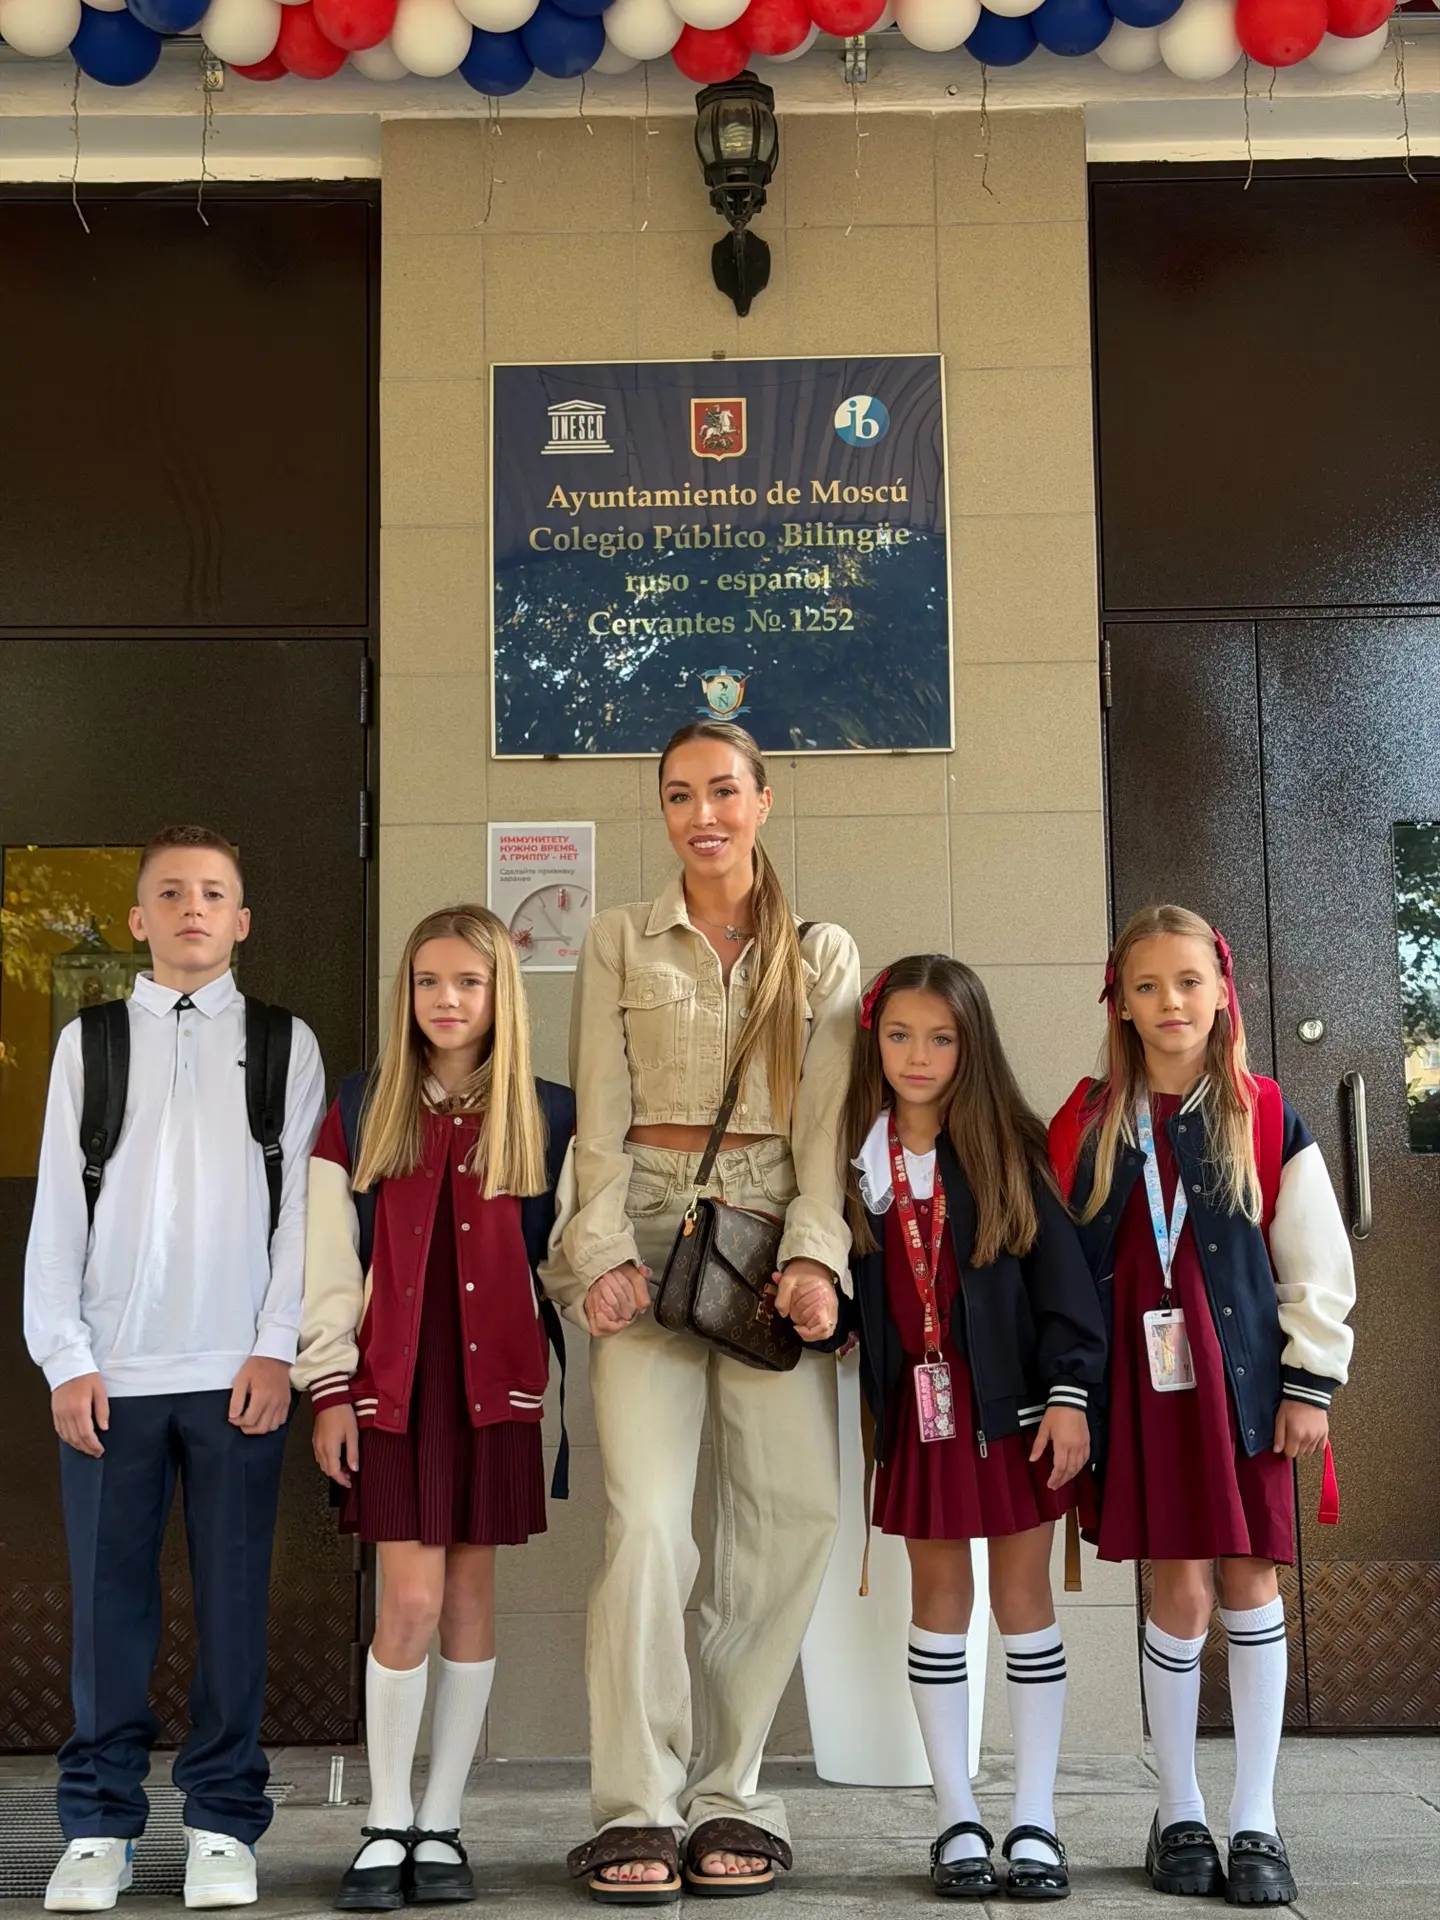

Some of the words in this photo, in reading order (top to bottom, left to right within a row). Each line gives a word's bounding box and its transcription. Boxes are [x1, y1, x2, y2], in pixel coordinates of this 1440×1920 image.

[551, 414, 604, 441] UNESCO
[846, 399, 880, 441] ib
[546, 481, 758, 517] Ayuntamiento
[766, 479, 802, 506] de
[810, 477, 909, 504] Moscú
[529, 524, 645, 559] Colegio
[652, 523, 766, 549] Público
[782, 521, 911, 554] Bilingüe
[624, 573, 690, 593] ruso
[716, 564, 832, 599] español
[587, 610, 737, 636] Cervantes
[789, 607, 855, 633] 1252
[499, 835, 570, 844] ИММУНИТЕТУ
[499, 844, 539, 853] НУЖНО
[540, 844, 578, 853] ВРЕМЯ,
[499, 854, 507, 862] А
[510, 853, 551, 861] ГРИППУ
[559, 853, 579, 861] НЕТ
[499, 868, 537, 876] Сделайте
[538, 868, 576, 876] прививку
